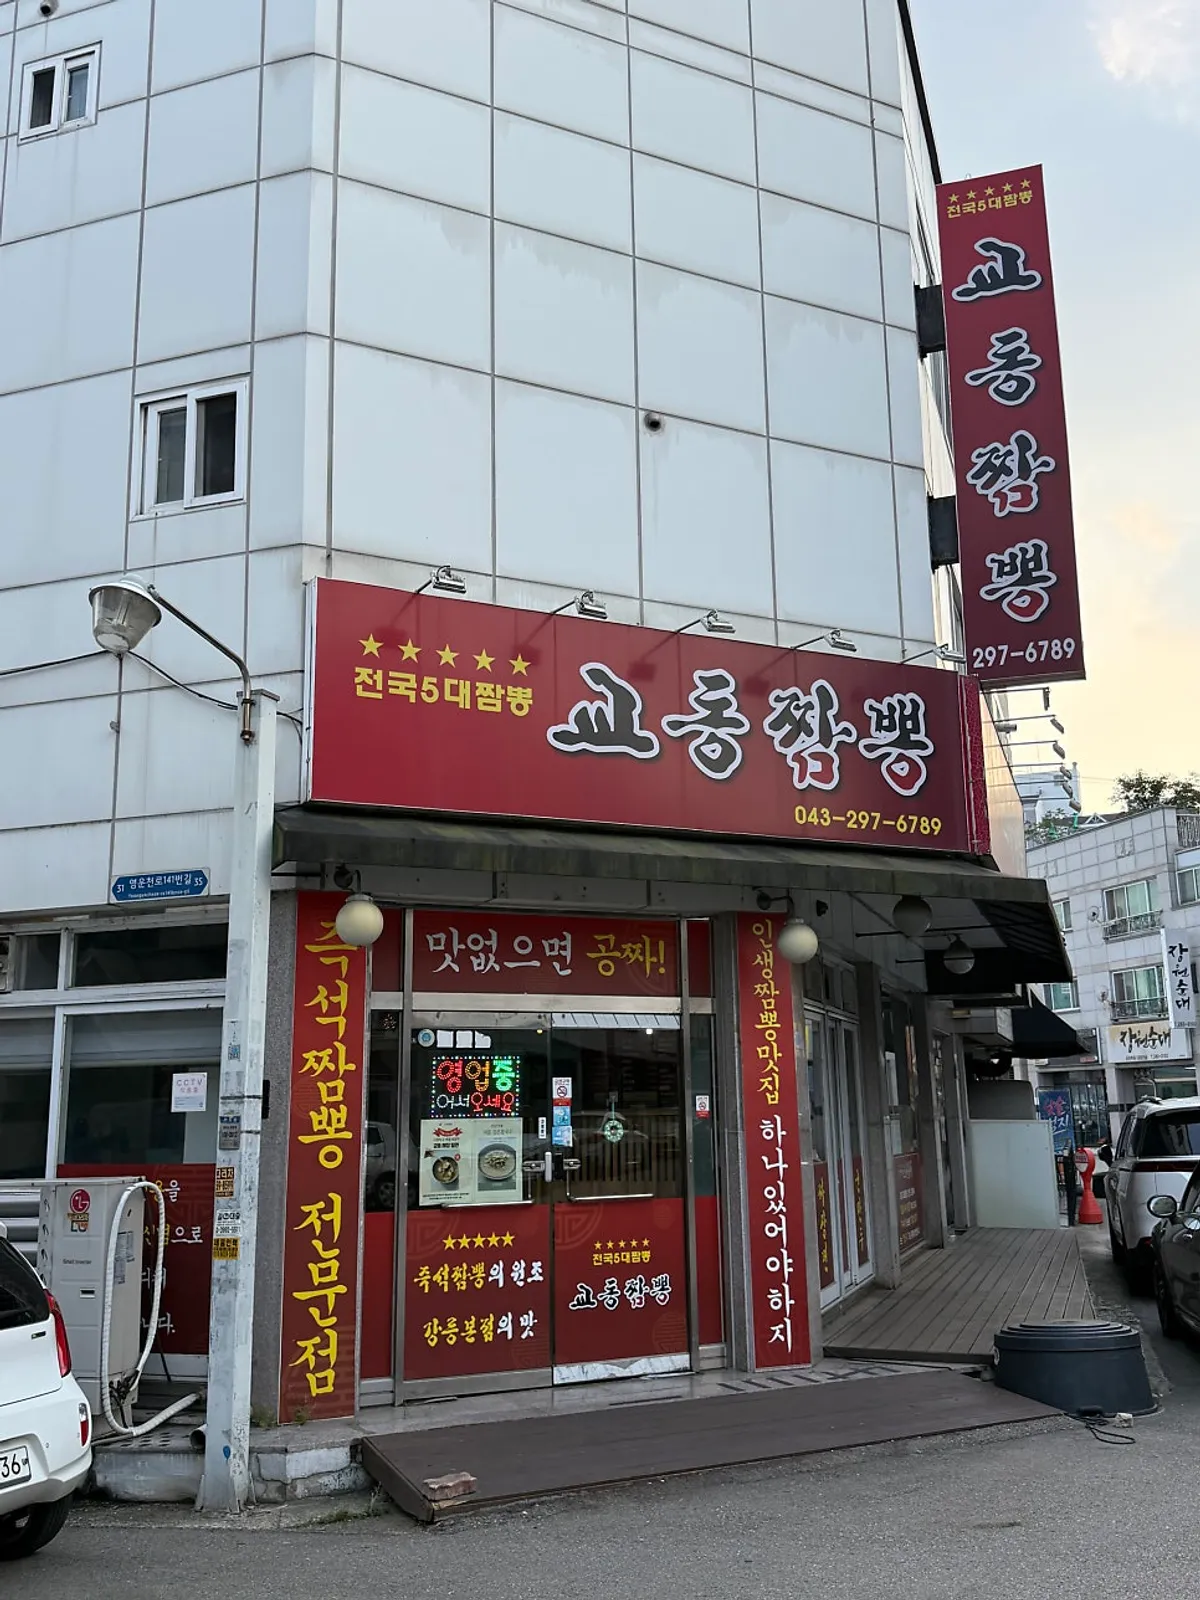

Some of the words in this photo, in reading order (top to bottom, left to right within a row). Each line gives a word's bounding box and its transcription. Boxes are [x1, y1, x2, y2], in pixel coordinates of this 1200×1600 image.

[947, 190, 1033, 219] 전국5대짬뽕
[951, 237, 1057, 623] 교동짬뽕
[972, 637, 1076, 669] 297-6789
[353, 666, 534, 718] 전국5대짬뽕
[546, 661, 935, 797] 교동짬뽕
[794, 805, 942, 836] 043-297-6789
[425, 927, 573, 977] 맛없으면
[586, 933, 666, 979] 공짜!
[297, 921, 358, 1169] 즉석짬뽕
[436, 1059, 516, 1094] 영업중
[436, 1092, 515, 1112] 어서오세요
[413, 1259, 505, 1294] 즉석짬뽕의
[510, 1259, 544, 1288] 원조
[592, 1251, 652, 1266] 전국5대짬뽕
[288, 1192, 348, 1397] 전문점
[568, 1273, 672, 1311] 교동짬뽕
[423, 1312, 513, 1347] 강릉본점의
[519, 1310, 538, 1340] 맛
